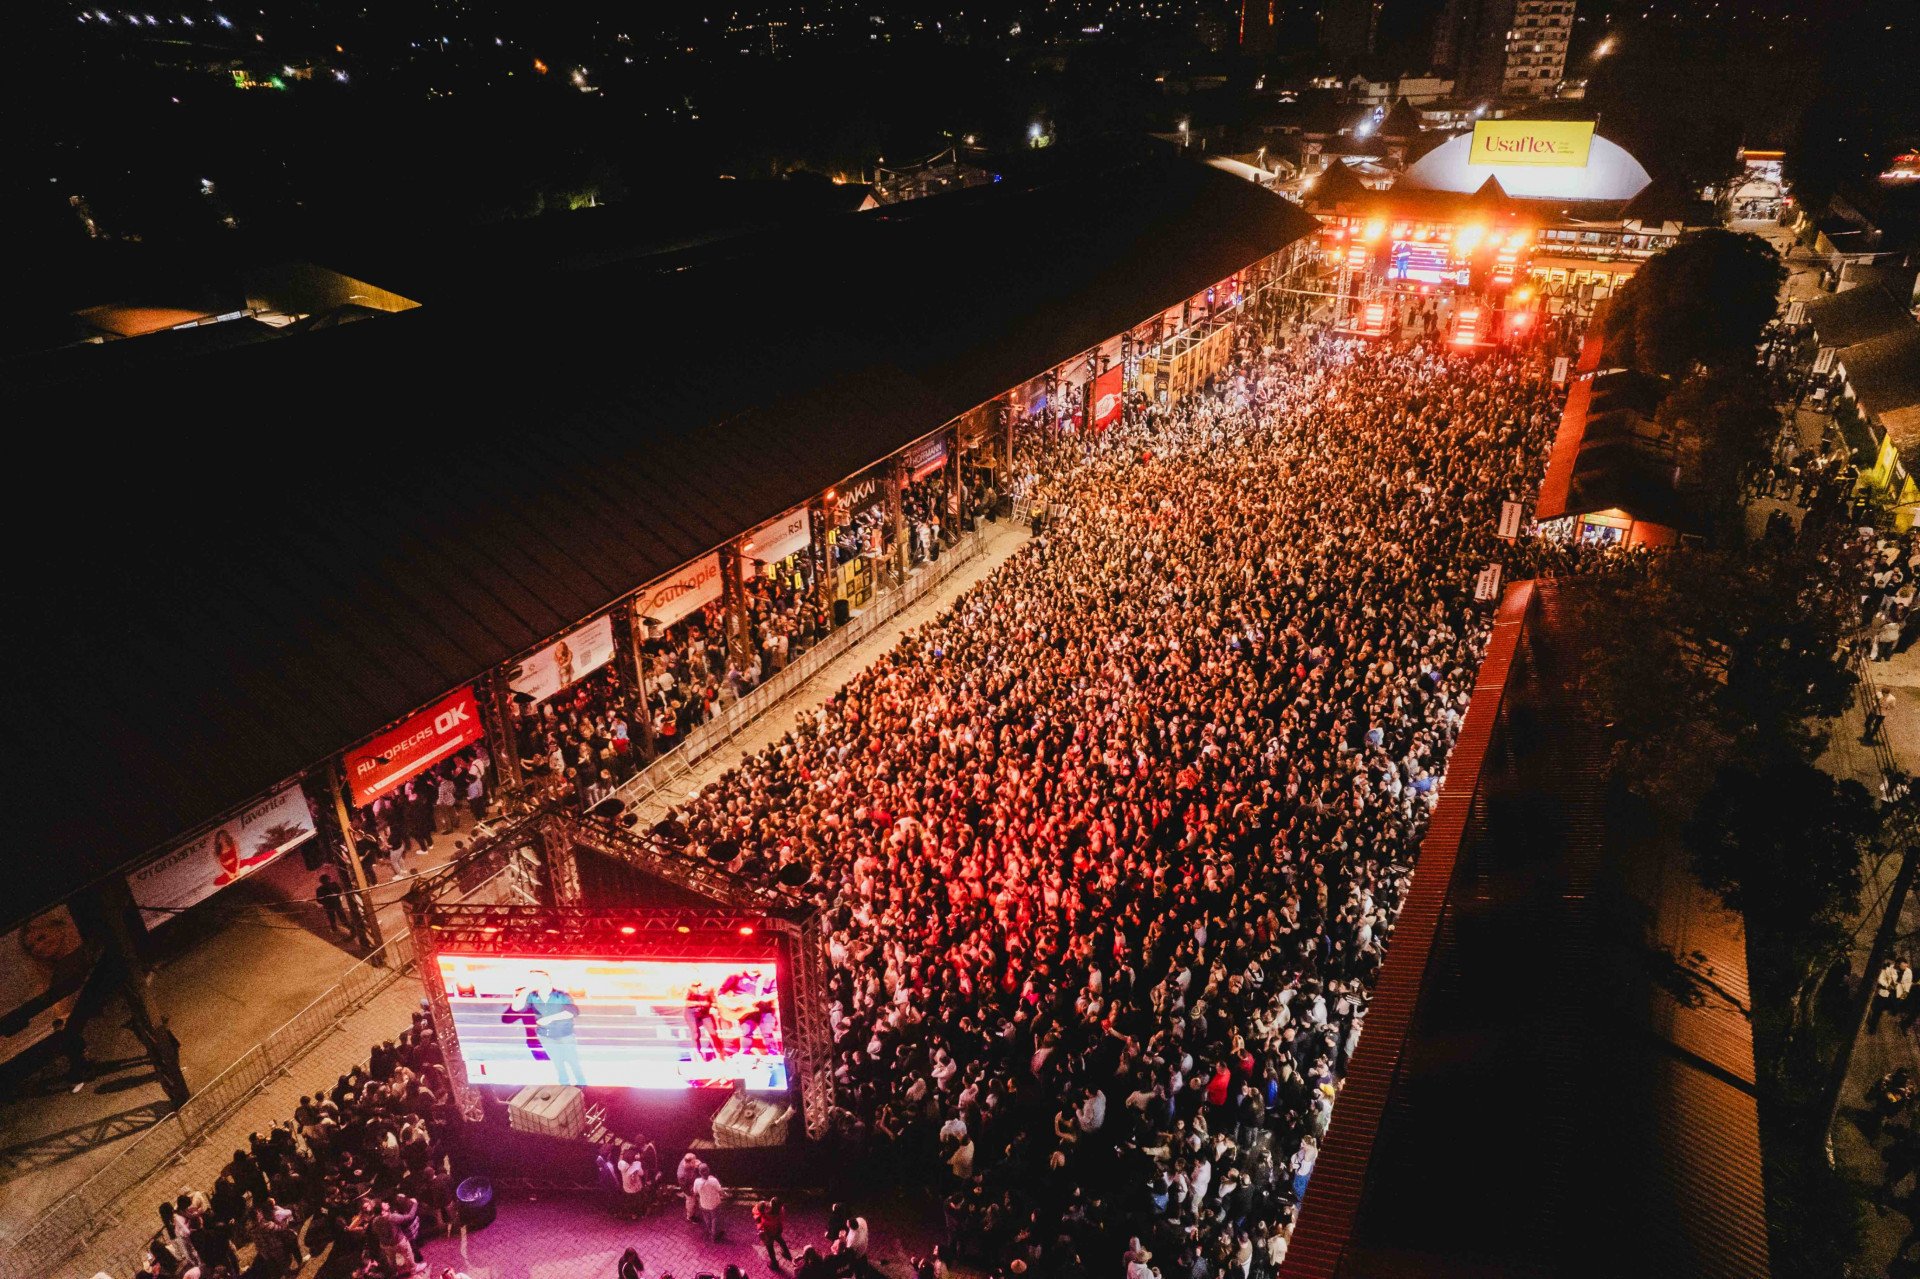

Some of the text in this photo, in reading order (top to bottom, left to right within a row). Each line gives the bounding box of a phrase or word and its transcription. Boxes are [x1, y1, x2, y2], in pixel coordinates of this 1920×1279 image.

[1485, 136, 1557, 154] Usaflex
[787, 519, 803, 536] RSI
[653, 564, 718, 609] Gutkopie
[434, 701, 470, 735] OK
